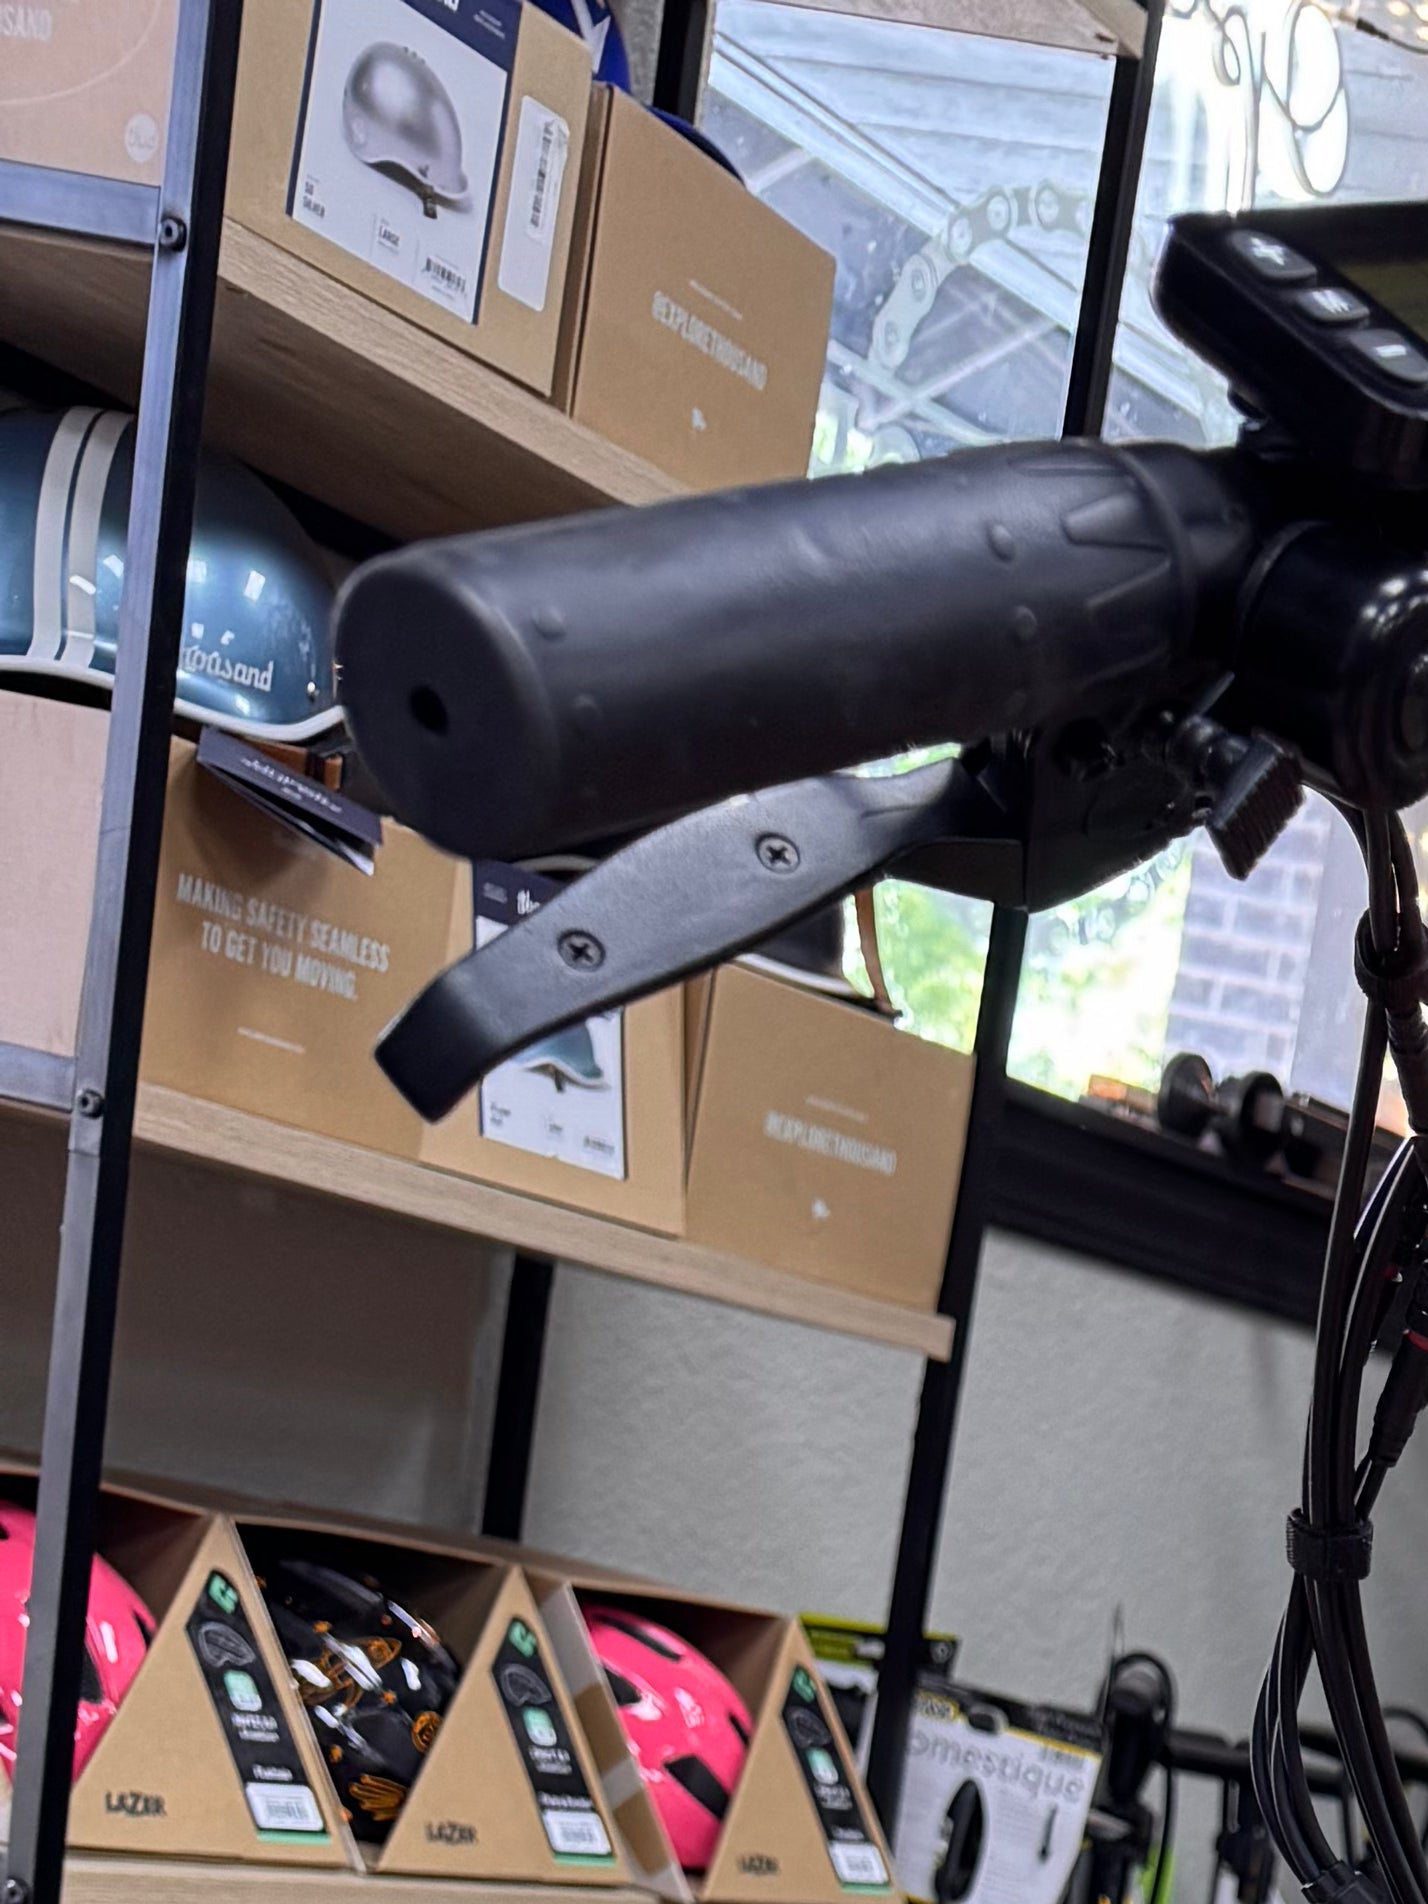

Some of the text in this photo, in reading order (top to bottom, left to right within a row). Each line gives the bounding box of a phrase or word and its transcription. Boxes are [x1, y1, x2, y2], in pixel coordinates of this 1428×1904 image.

[175, 871, 391, 974] MAKING SAFETY SEAMLESS
[202, 920, 223, 954] TO
[225, 928, 258, 965] GET
[261, 940, 293, 979] YOU
[105, 1790, 167, 1818] LAZER
[425, 1819, 478, 1846] LAZER
